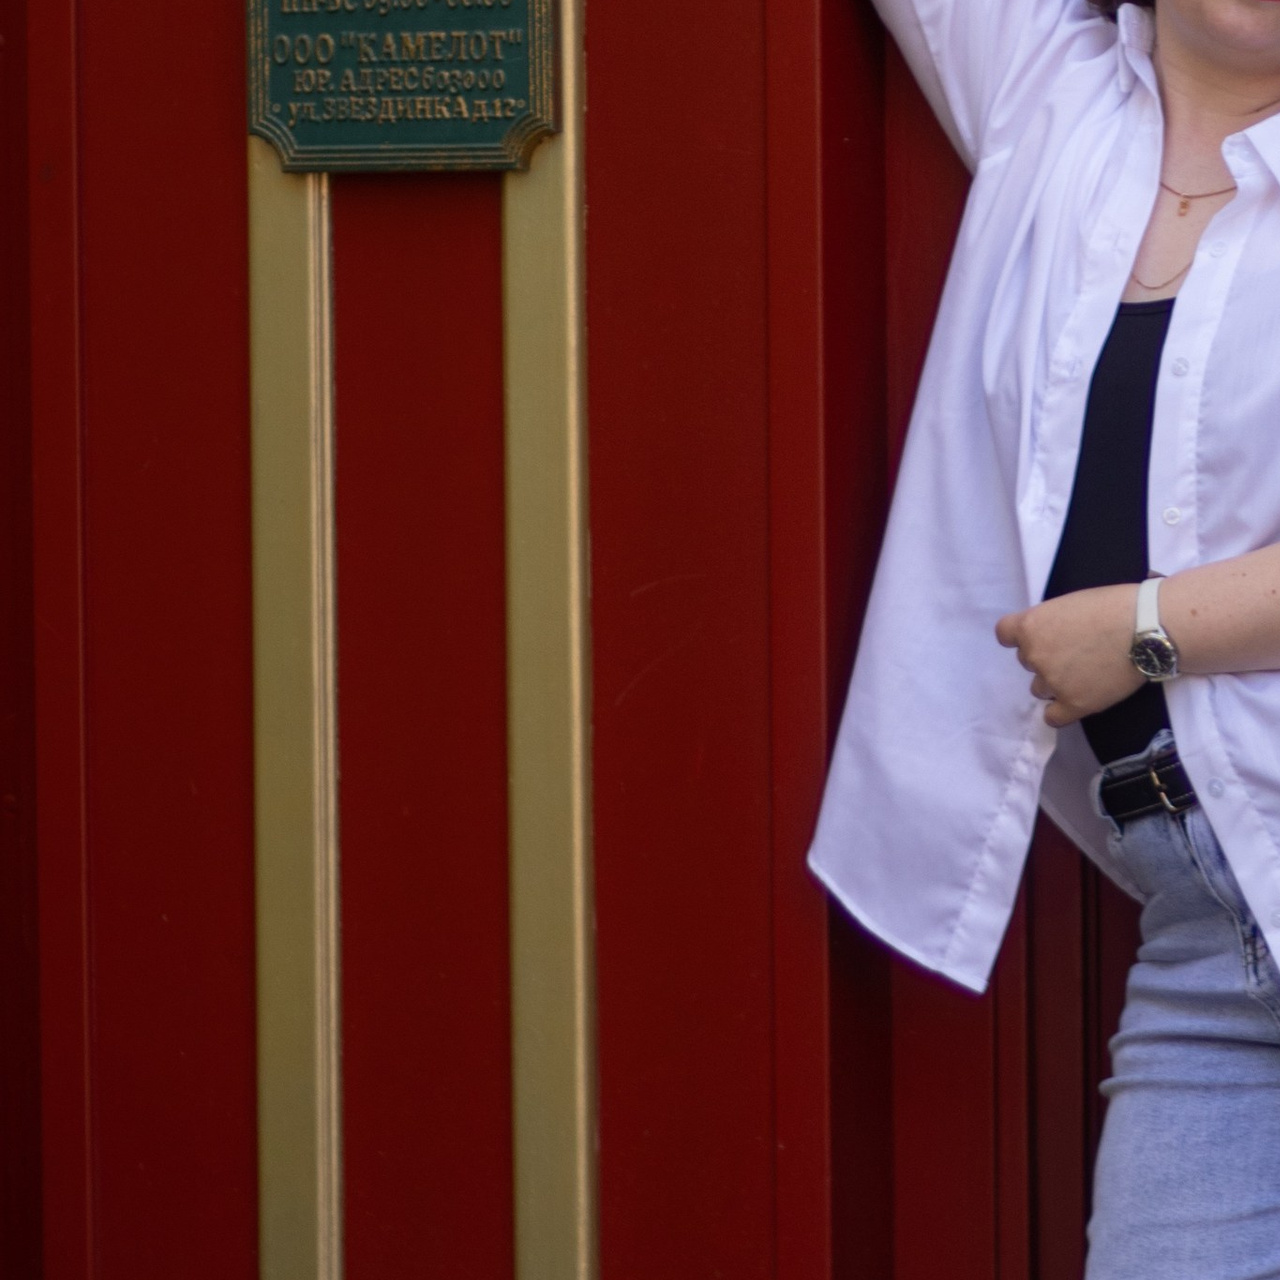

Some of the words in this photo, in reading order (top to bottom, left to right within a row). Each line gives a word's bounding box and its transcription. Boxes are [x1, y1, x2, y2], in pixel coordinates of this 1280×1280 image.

[272, 32, 336, 64] ООО
[340, 28, 523, 63] "КАМЕЛОТ"
[293, 68, 335, 93] ЮР.
[339, 67, 419, 96] АДРЕС
